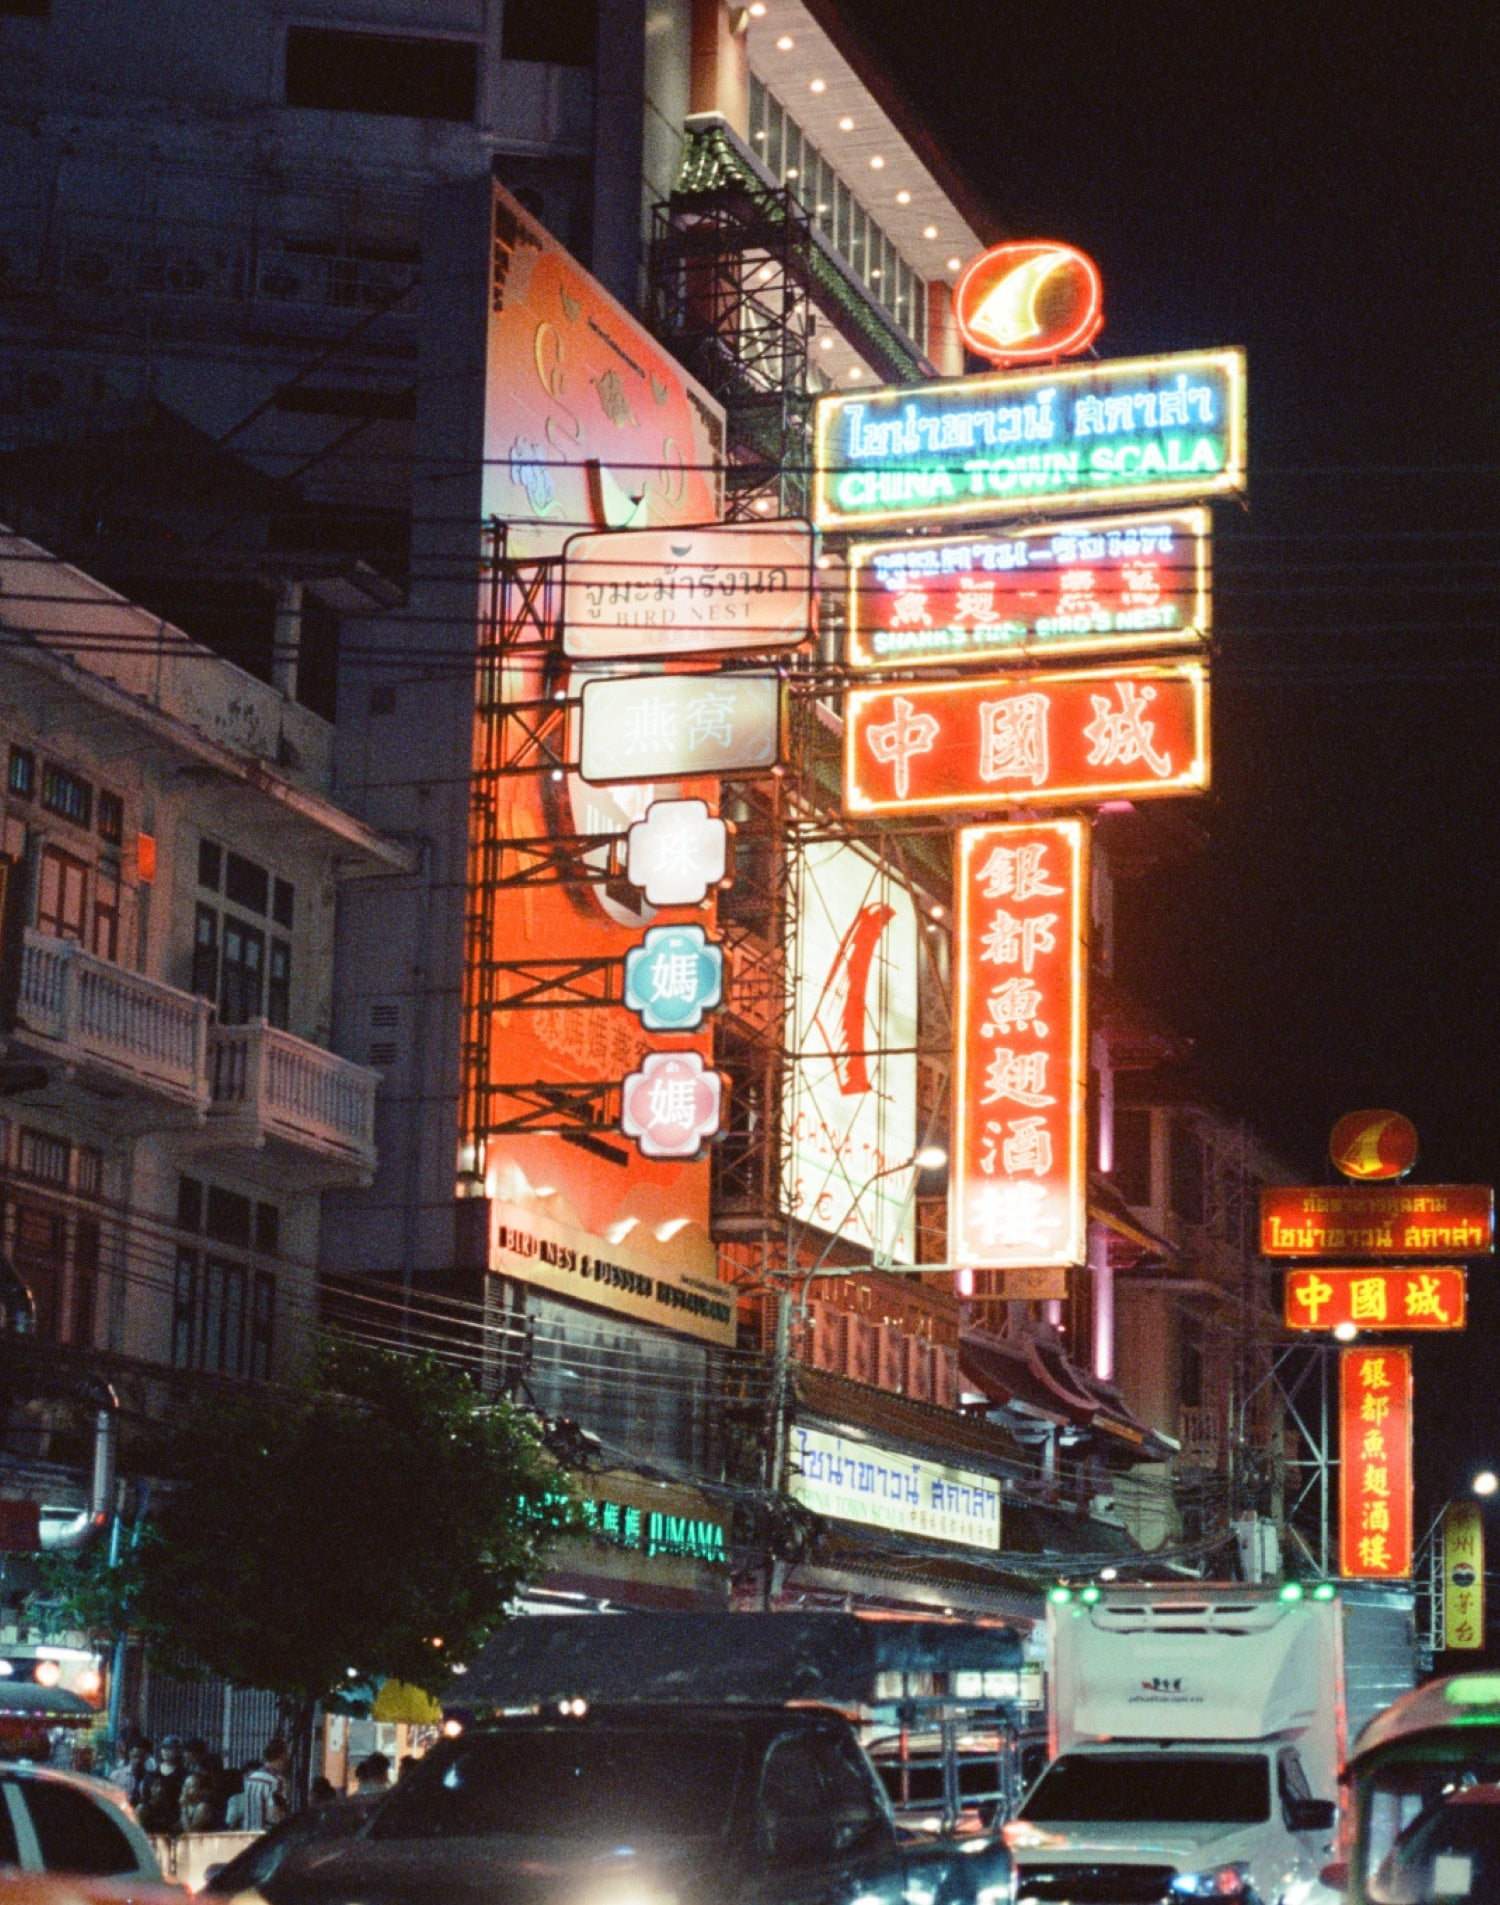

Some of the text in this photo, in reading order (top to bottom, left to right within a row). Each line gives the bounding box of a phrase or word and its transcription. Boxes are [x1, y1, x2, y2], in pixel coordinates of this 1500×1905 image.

[838, 437, 1220, 506] CHINA TOWN SCALA
[586, 565, 788, 618] จูมะม้ารังนก
[617, 602, 753, 627] BIRD NEST
[1035, 611, 1111, 637] BIRD'S
[1115, 605, 1176, 631] NEST
[866, 681, 1171, 799] 中國城
[650, 952, 699, 1003] 媽
[647, 1077, 697, 1130] 媽
[1269, 1216, 1482, 1248] ไชน่าทาวน์ สกาล่า
[1295, 1274, 1449, 1324] 中國城
[796, 1430, 996, 1519] ไชน่าทาวน์ สกาล่า
[1358, 1357, 1392, 1571] 銀都魚翅酒樓
